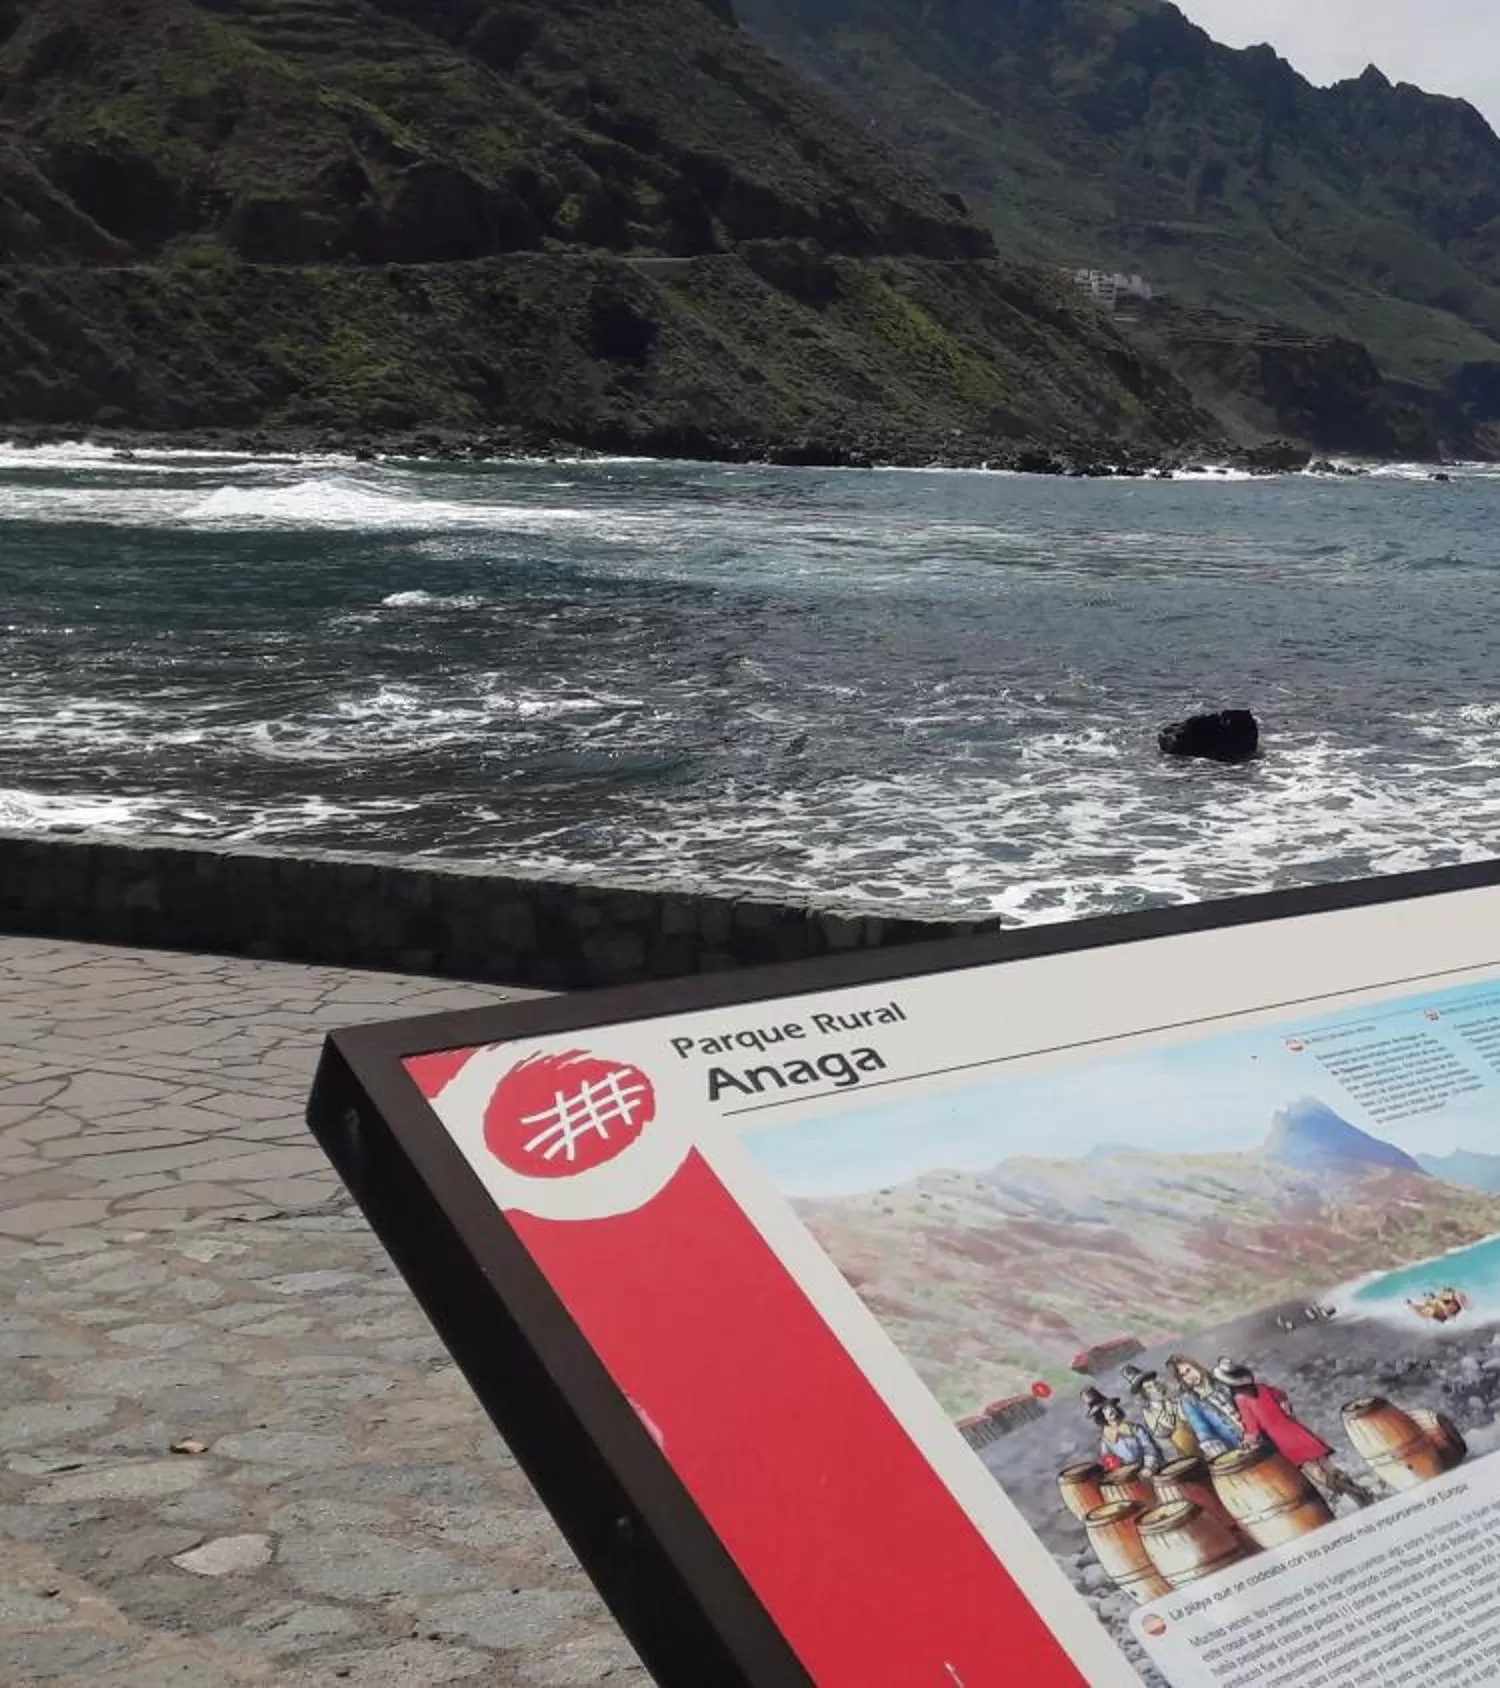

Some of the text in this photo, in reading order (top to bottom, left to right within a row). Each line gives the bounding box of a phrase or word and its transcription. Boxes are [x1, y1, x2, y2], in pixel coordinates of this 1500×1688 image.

[670, 1001, 908, 1060] Parque Rural
[706, 1046, 888, 1102] Anaga
